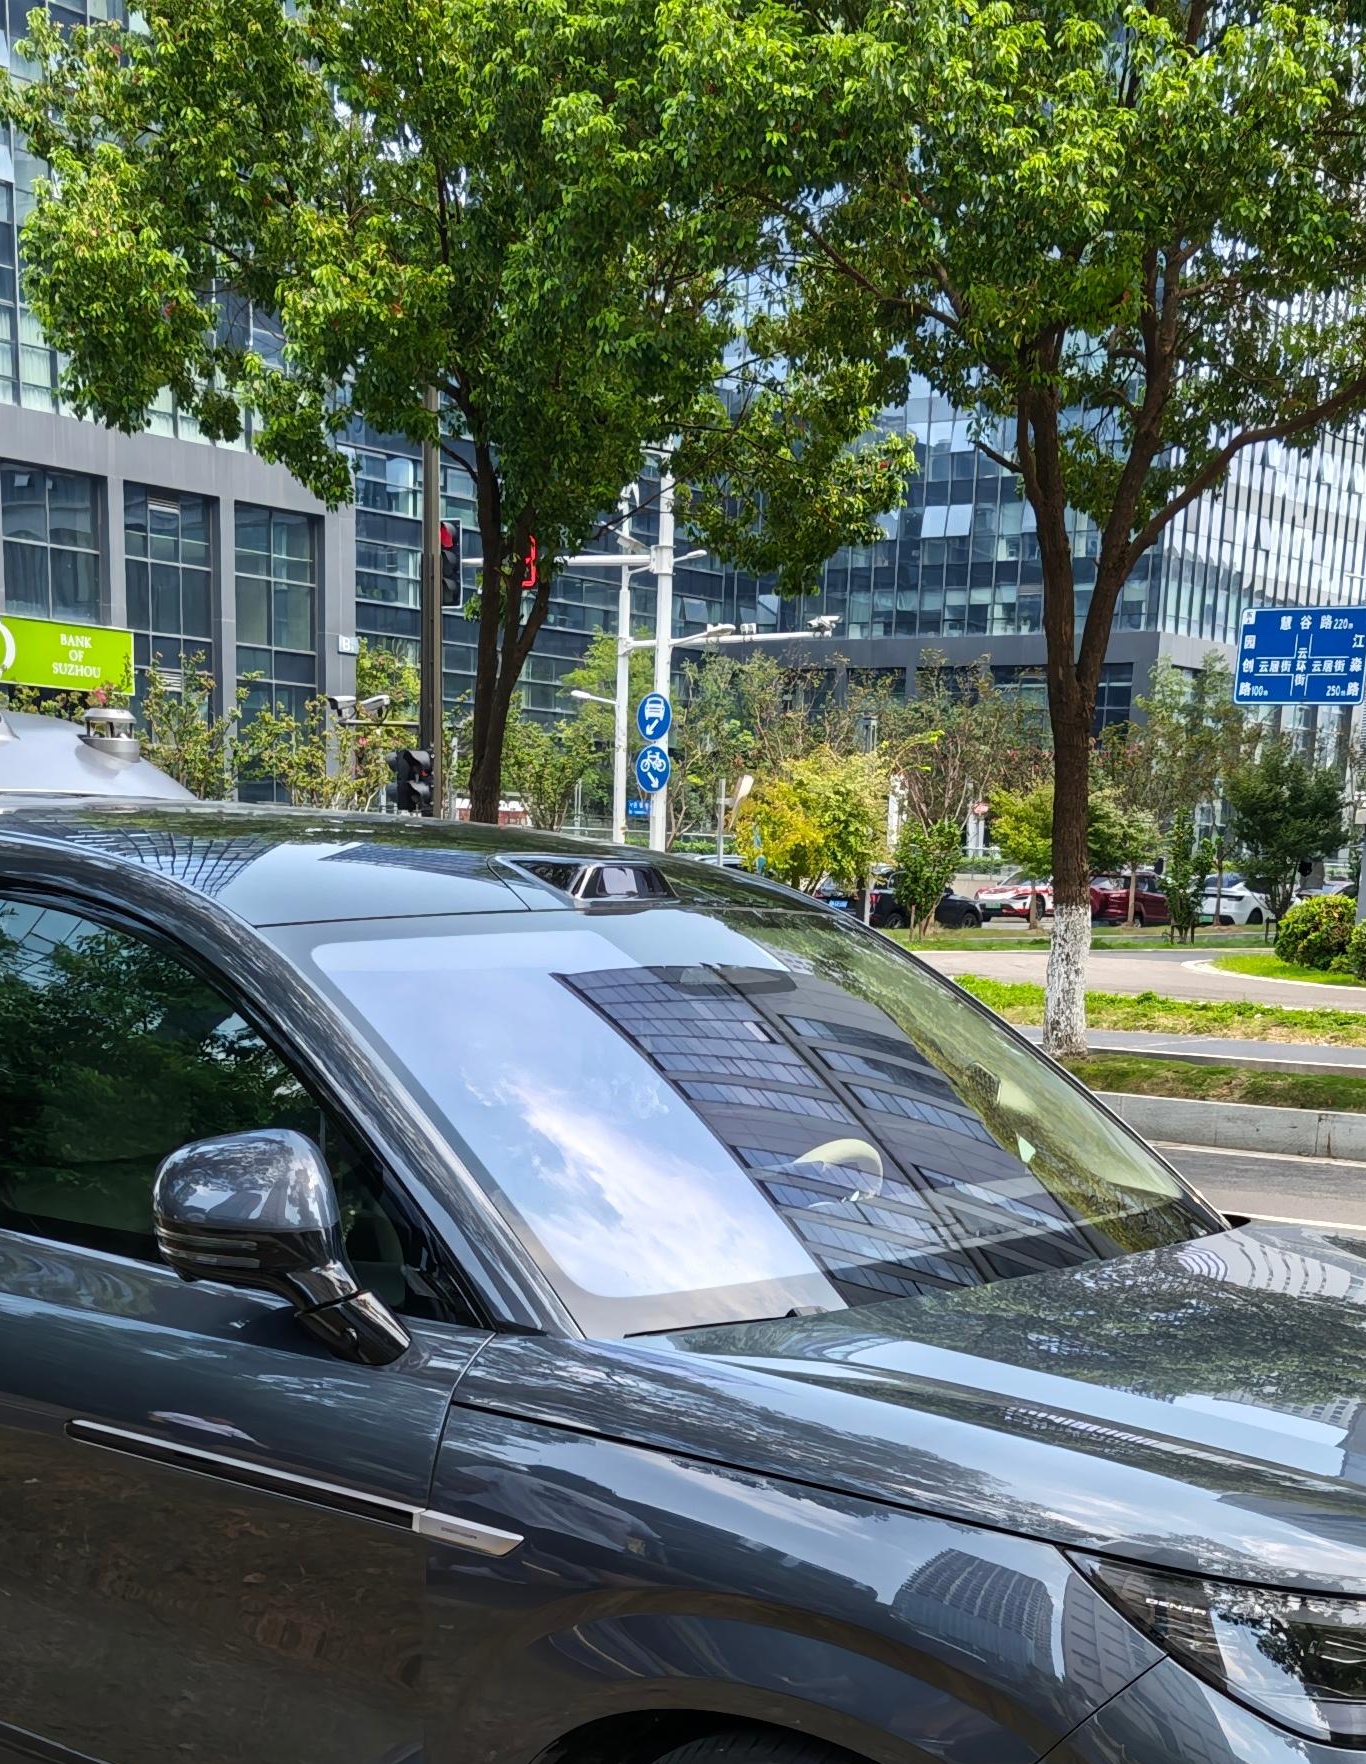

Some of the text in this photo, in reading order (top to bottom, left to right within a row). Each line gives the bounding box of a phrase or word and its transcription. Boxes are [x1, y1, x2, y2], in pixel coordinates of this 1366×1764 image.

[59, 633, 92, 649] BANK
[68, 650, 84, 662] OF
[52, 664, 101, 679] SUZHOU
